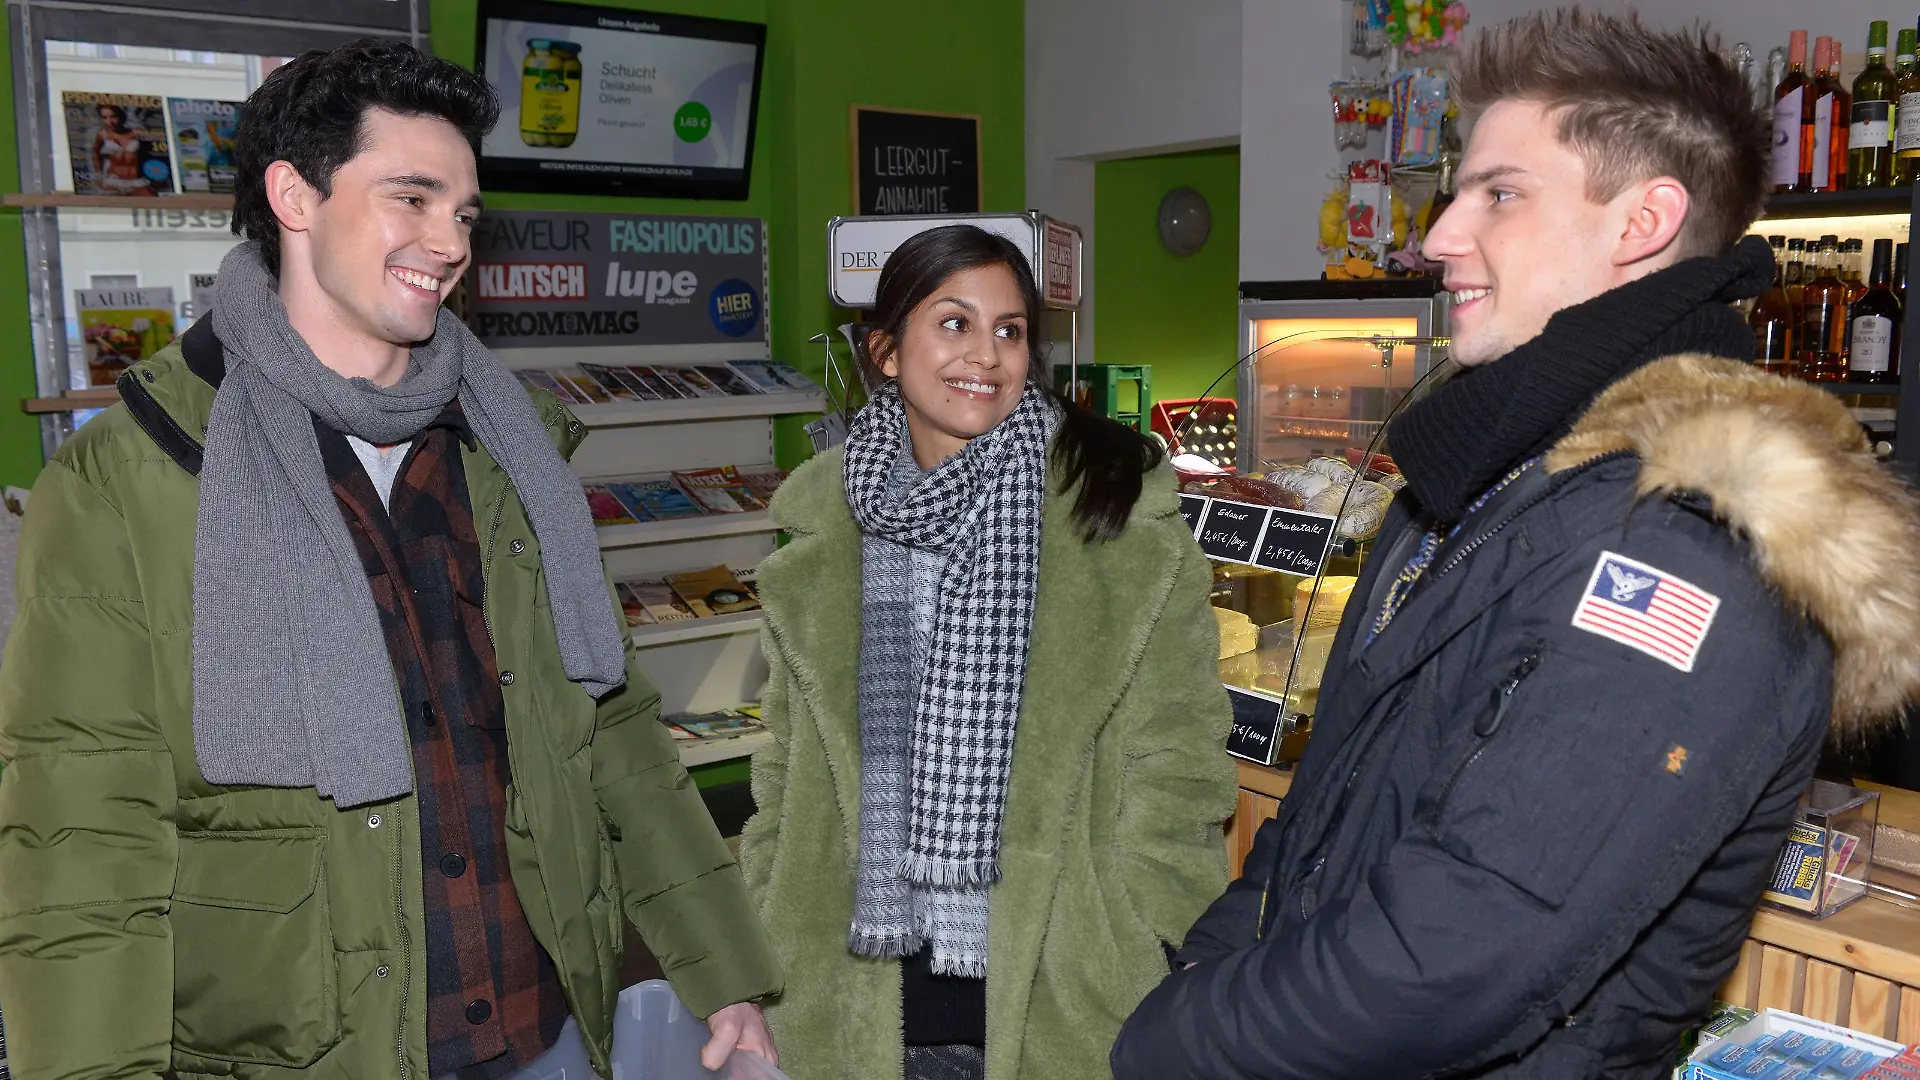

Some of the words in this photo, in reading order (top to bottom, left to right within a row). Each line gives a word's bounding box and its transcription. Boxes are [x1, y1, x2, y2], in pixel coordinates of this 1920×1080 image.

[602, 61, 656, 79] Schucht
[598, 93, 631, 105] Oliven
[175, 100, 235, 117] photo
[875, 146, 963, 176] LEERGUT-
[875, 186, 949, 213] ANNAHME
[476, 218, 591, 252] FAVEUR
[610, 220, 755, 255] FASHIOPOLIS
[841, 251, 878, 268] DER
[478, 265, 585, 297] KLATSCH
[605, 262, 698, 304] lupe
[80, 291, 150, 307] LAUBE
[657, 297, 690, 306] magazin
[716, 292, 753, 314] HIER
[1853, 334, 1887, 344] BRANDY
[1217, 508, 1249, 521] Edamer
